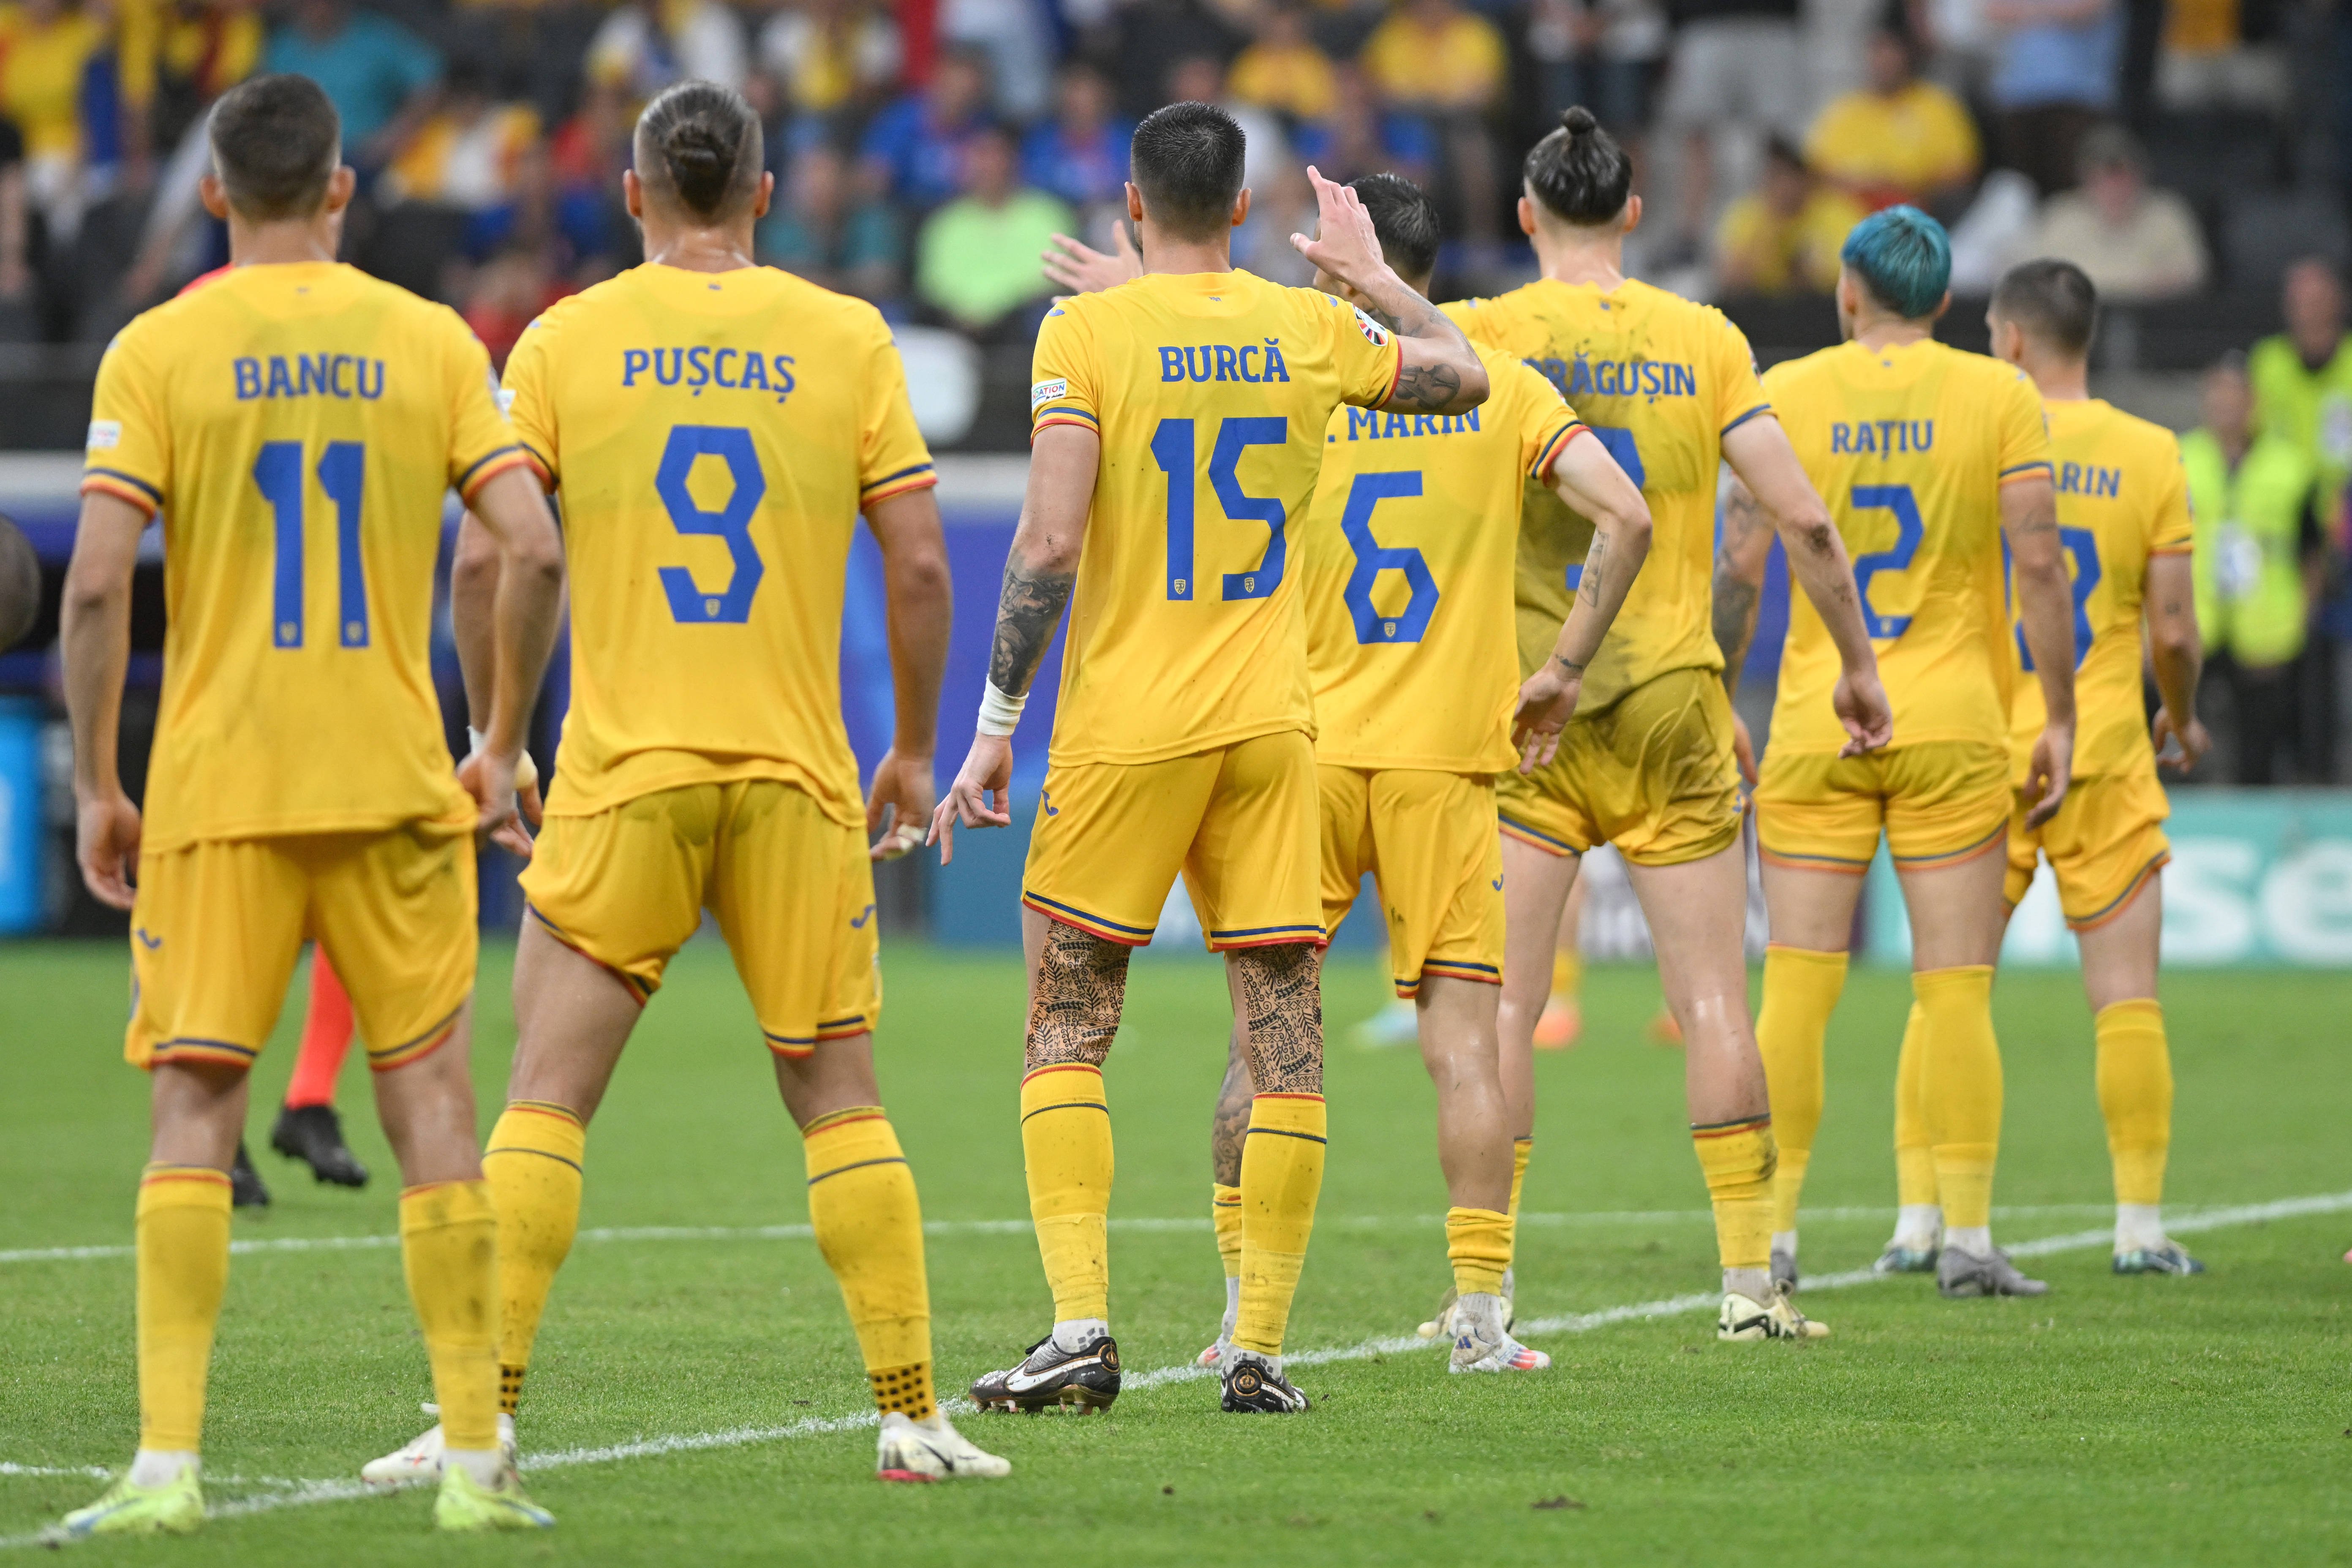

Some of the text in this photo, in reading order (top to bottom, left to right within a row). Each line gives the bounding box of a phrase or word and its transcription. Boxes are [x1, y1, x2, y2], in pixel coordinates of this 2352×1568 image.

[234, 353, 384, 400] BANCU
[622, 346, 795, 403] PUȘCAȘ
[1158, 337, 1290, 383] BURCĂ
[1150, 416, 1288, 601] 15
[1832, 420, 1933, 460] RAȚIU
[253, 441, 370, 648] 11
[654, 425, 766, 624] 9
[1341, 470, 1440, 645] 6
[1851, 485, 1925, 640] 2
